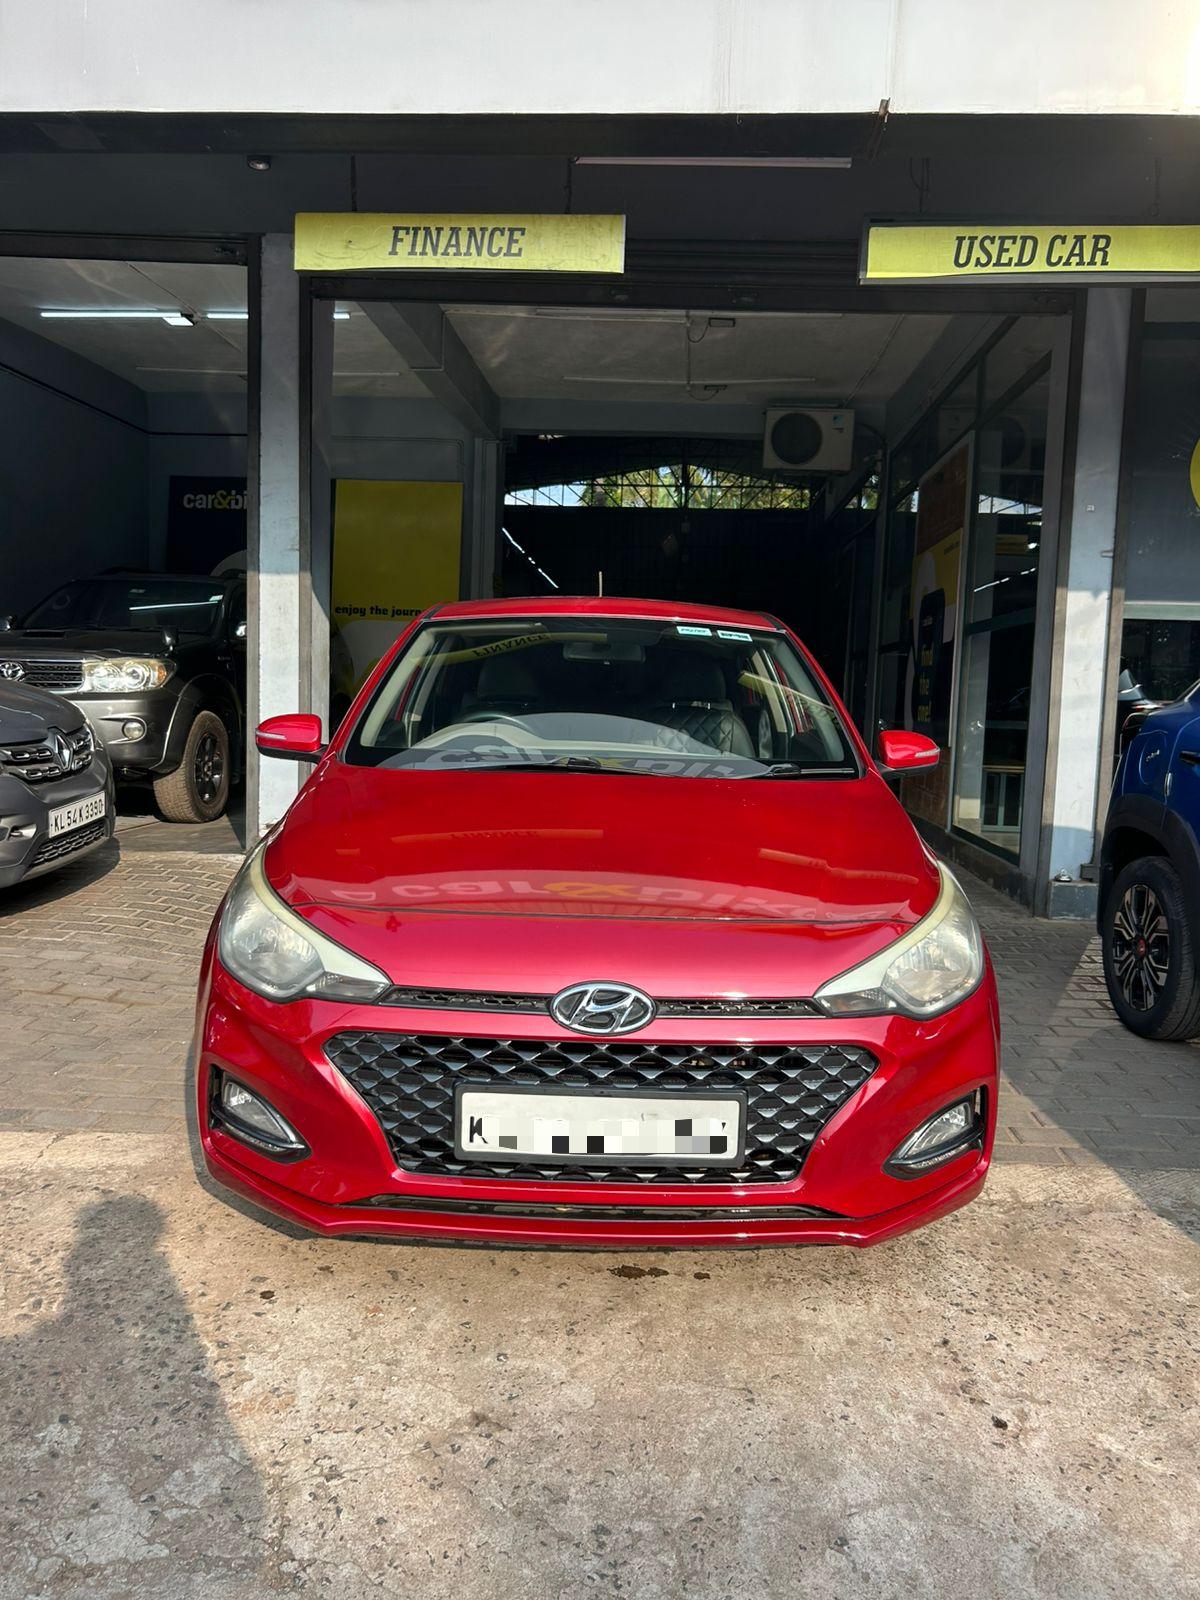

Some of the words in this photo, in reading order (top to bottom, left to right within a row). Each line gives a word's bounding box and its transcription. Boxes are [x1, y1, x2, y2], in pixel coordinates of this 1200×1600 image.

[389, 226, 526, 257] FINANCE
[953, 235, 1040, 268] USED
[1046, 234, 1111, 268] CAR
[335, 605, 366, 617] enjoy
[370, 605, 388, 615] the
[54, 815, 65, 832] KL
